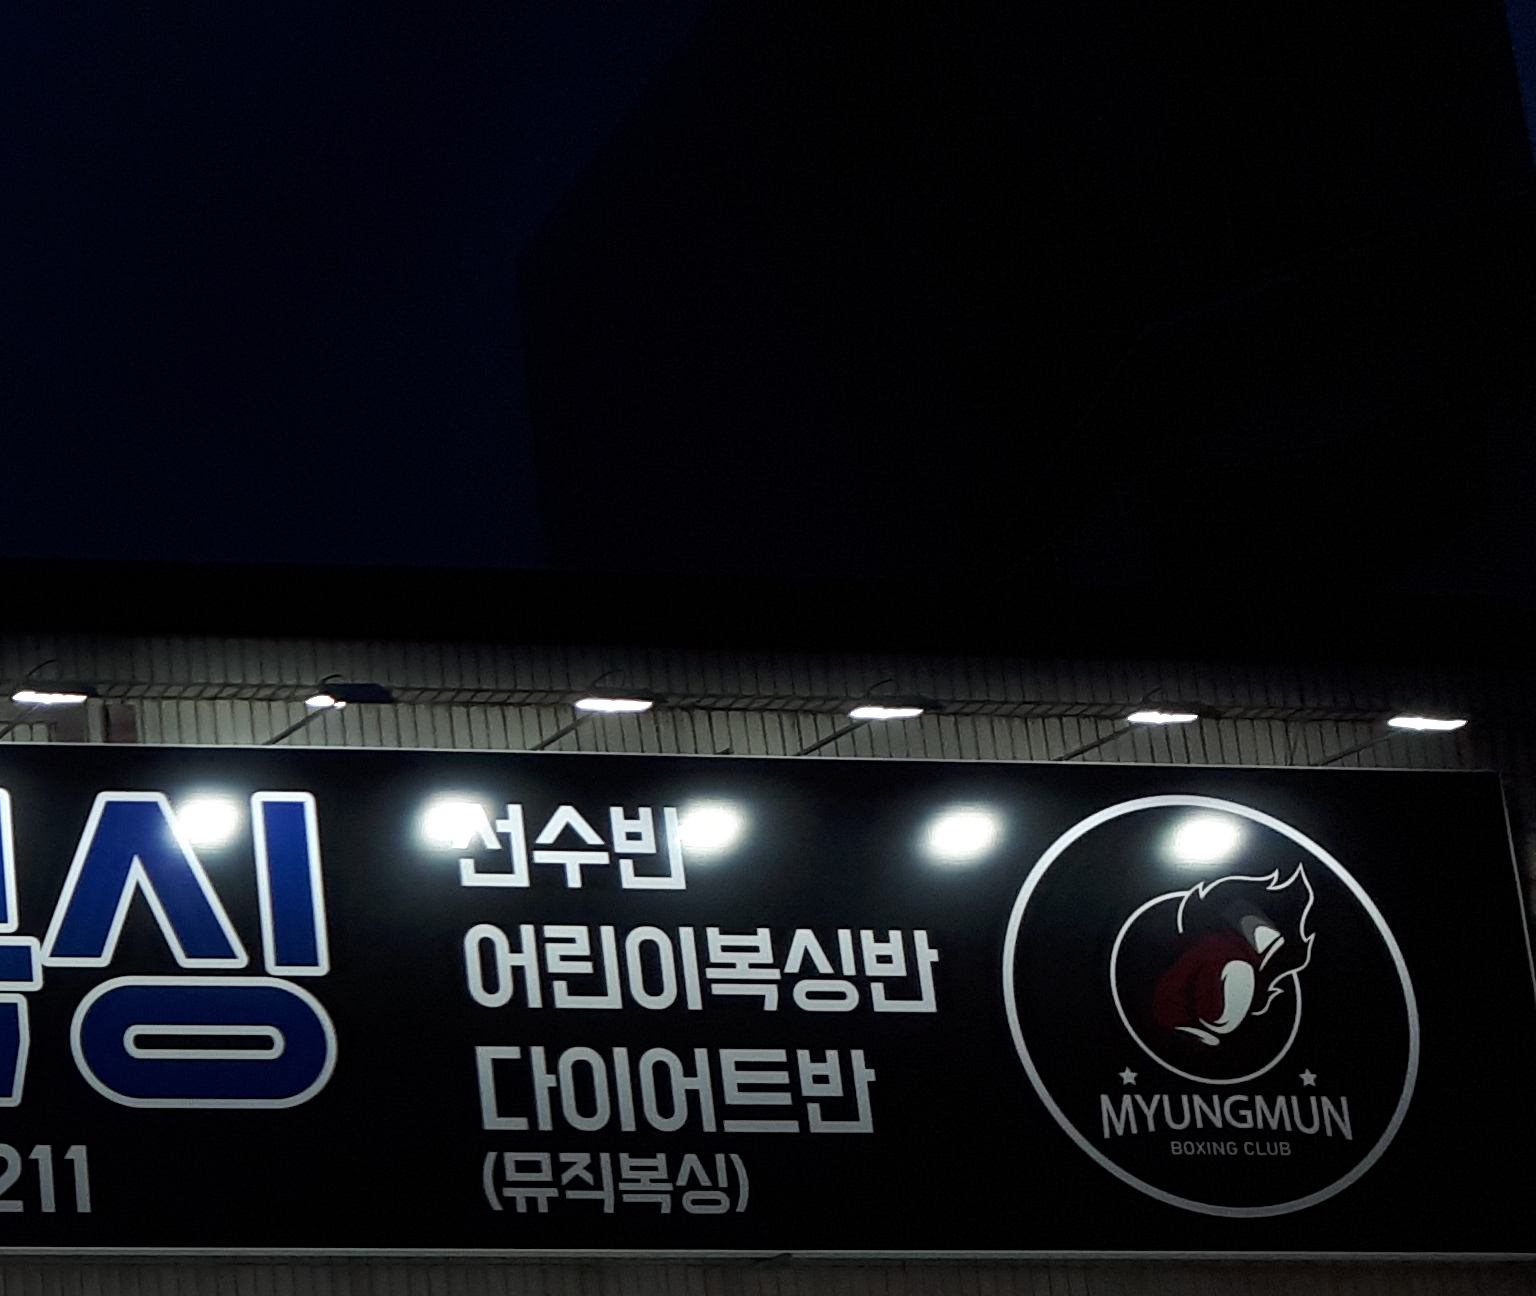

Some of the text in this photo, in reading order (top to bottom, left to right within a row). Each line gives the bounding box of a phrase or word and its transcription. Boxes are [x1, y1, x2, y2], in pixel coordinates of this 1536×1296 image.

[452, 802, 688, 890] 선수반
[463, 923, 940, 1013] 어린이복싱반
[475, 1045, 877, 1134] 다이어트반
[1100, 1093, 1354, 1141] MYUNGMUN
[482, 1150, 750, 1215] (뮤직복싱)
[1170, 1140, 1292, 1157] BOXING CLUB
